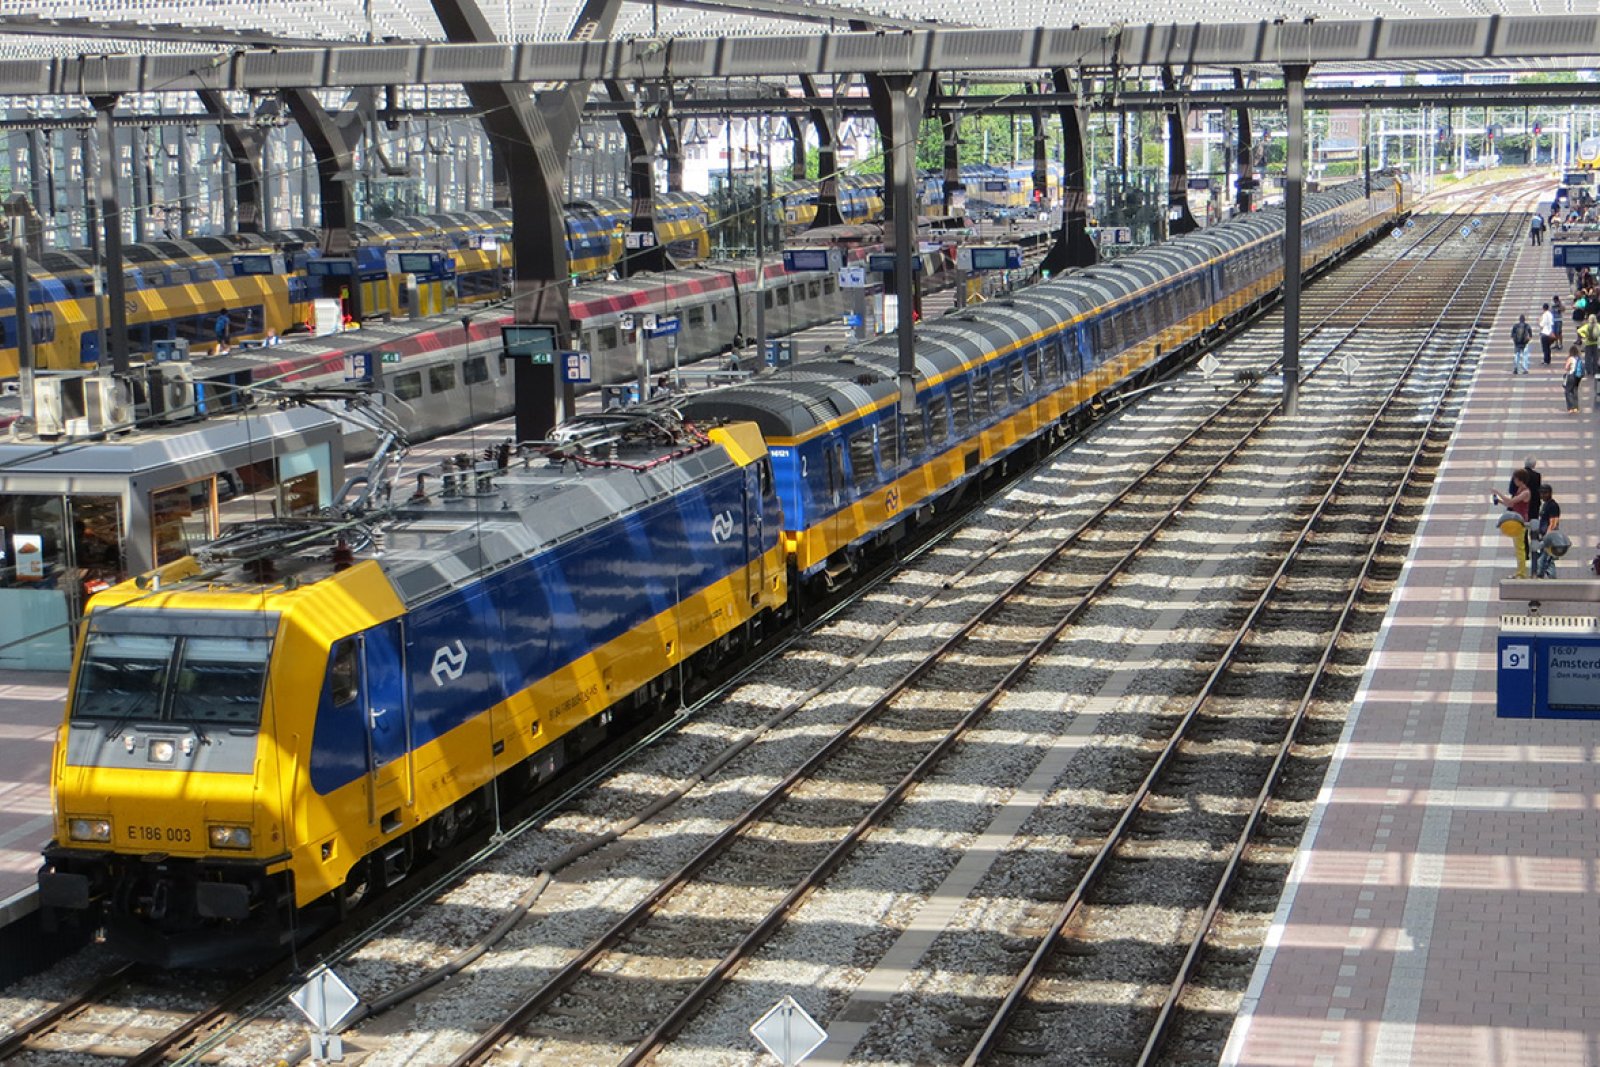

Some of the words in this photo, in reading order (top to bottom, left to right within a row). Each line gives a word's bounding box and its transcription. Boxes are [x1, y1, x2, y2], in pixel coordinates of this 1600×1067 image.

[1552, 646, 1578, 655] 16:07
[128, 826, 137, 840] E
[140, 826, 161, 841] 186
[167, 827, 191, 842] 003
